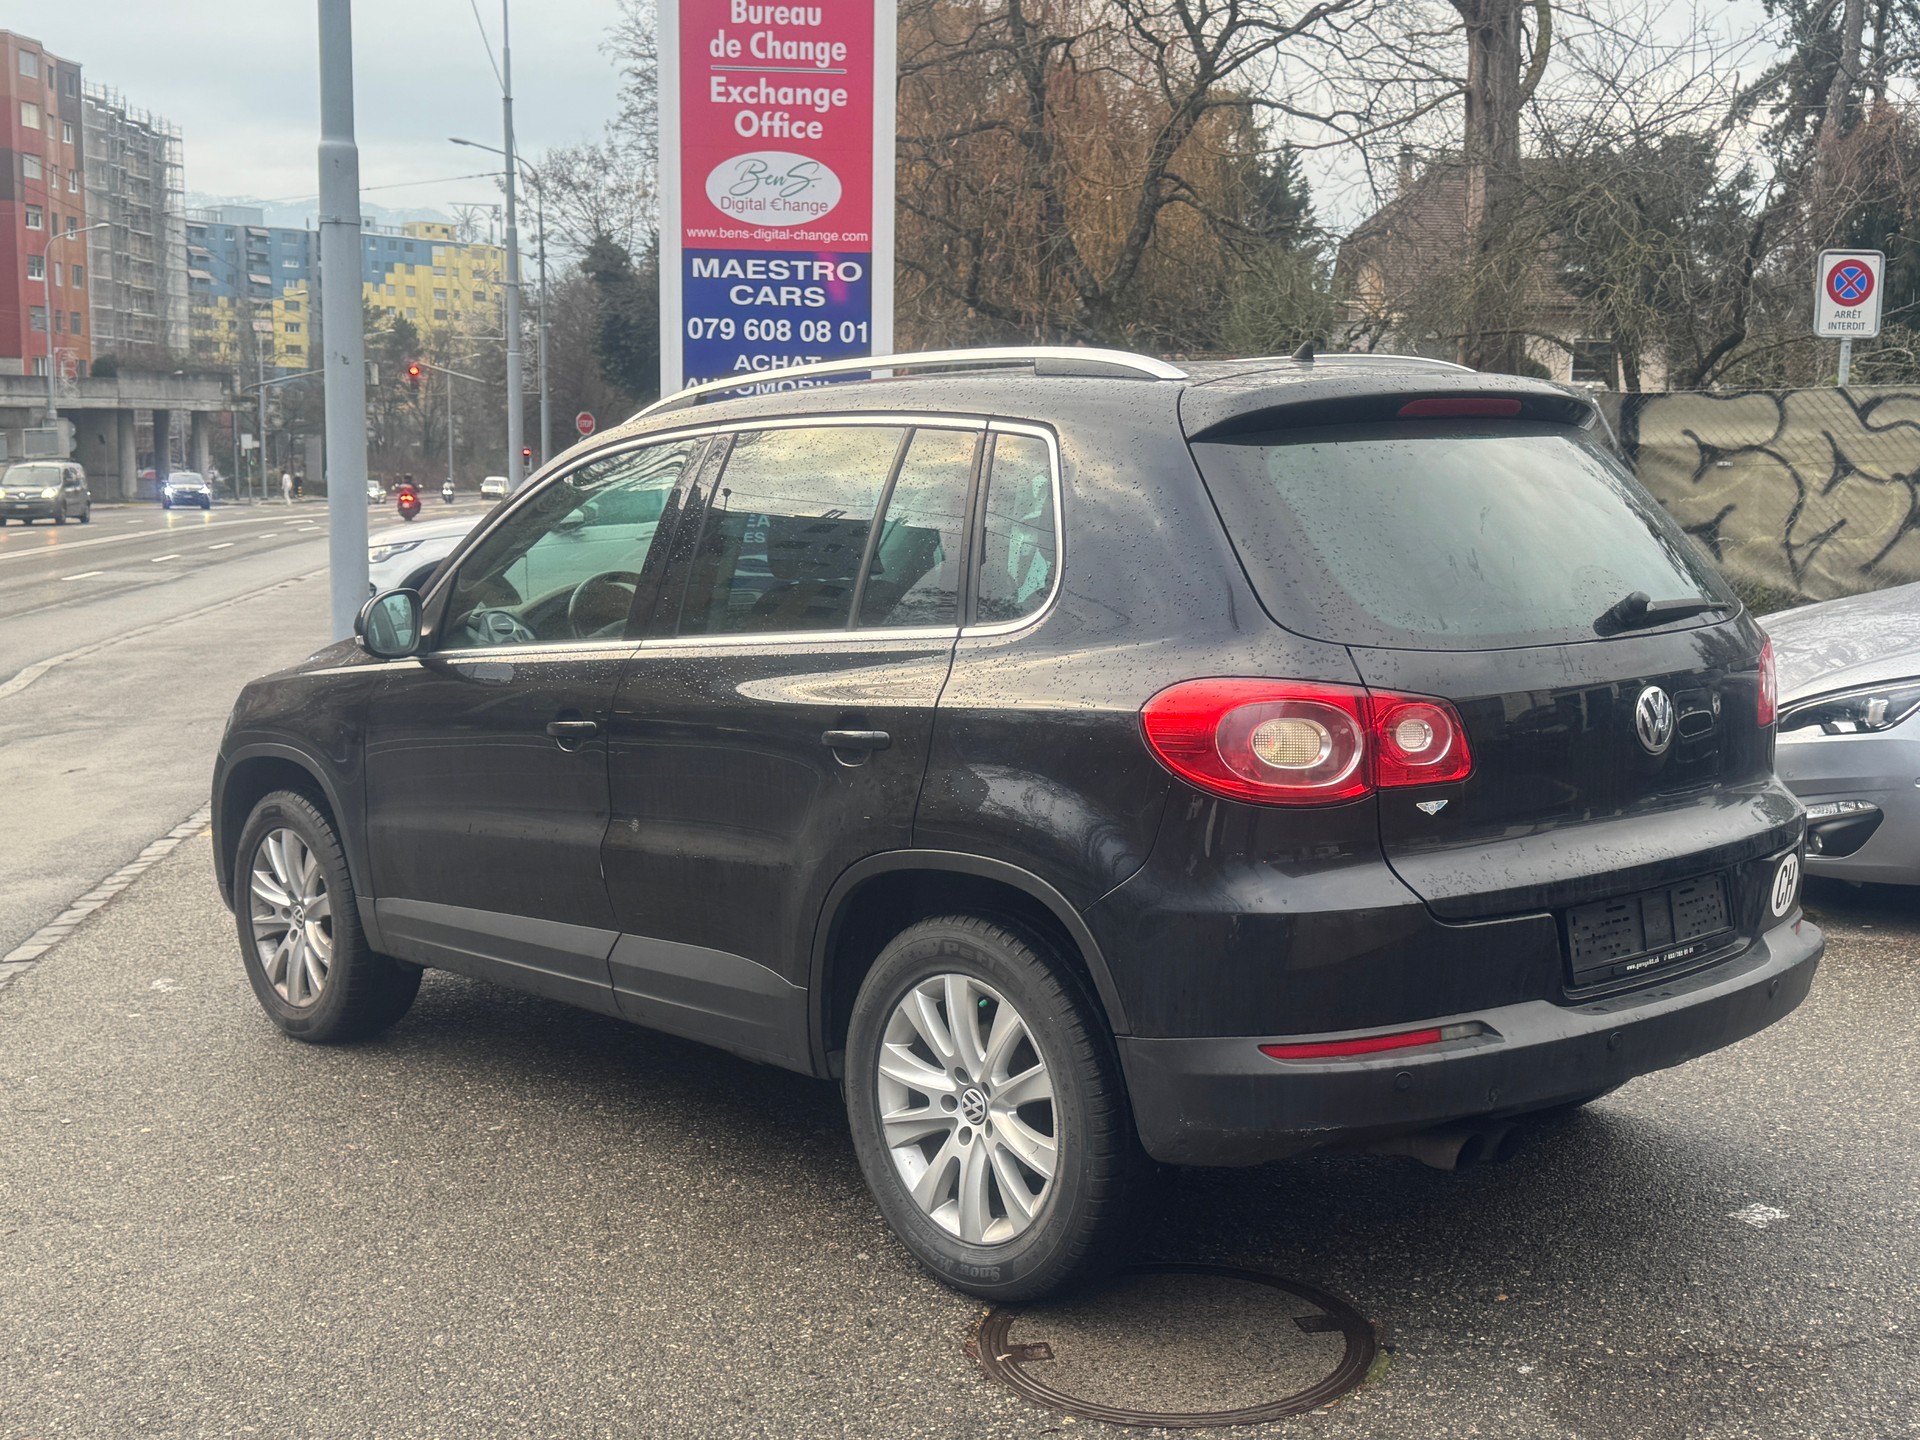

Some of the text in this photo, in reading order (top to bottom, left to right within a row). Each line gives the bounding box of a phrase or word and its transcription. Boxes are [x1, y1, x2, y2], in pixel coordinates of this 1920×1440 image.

[730, 0, 822, 26] Bureau
[709, 29, 847, 68] de Change
[710, 76, 848, 113] Exchange
[734, 110, 823, 139] Office
[720, 196, 766, 213] Digital
[687, 228, 868, 243] www.bens-digital-change.com
[692, 257, 863, 282] MAESTRO
[729, 285, 826, 307] CARS
[1828, 321, 1865, 331] INTERDIT
[1834, 309, 1861, 319] ARRÊT
[687, 317, 868, 343] 079 608 08 01
[1775, 861, 1796, 909] CH
